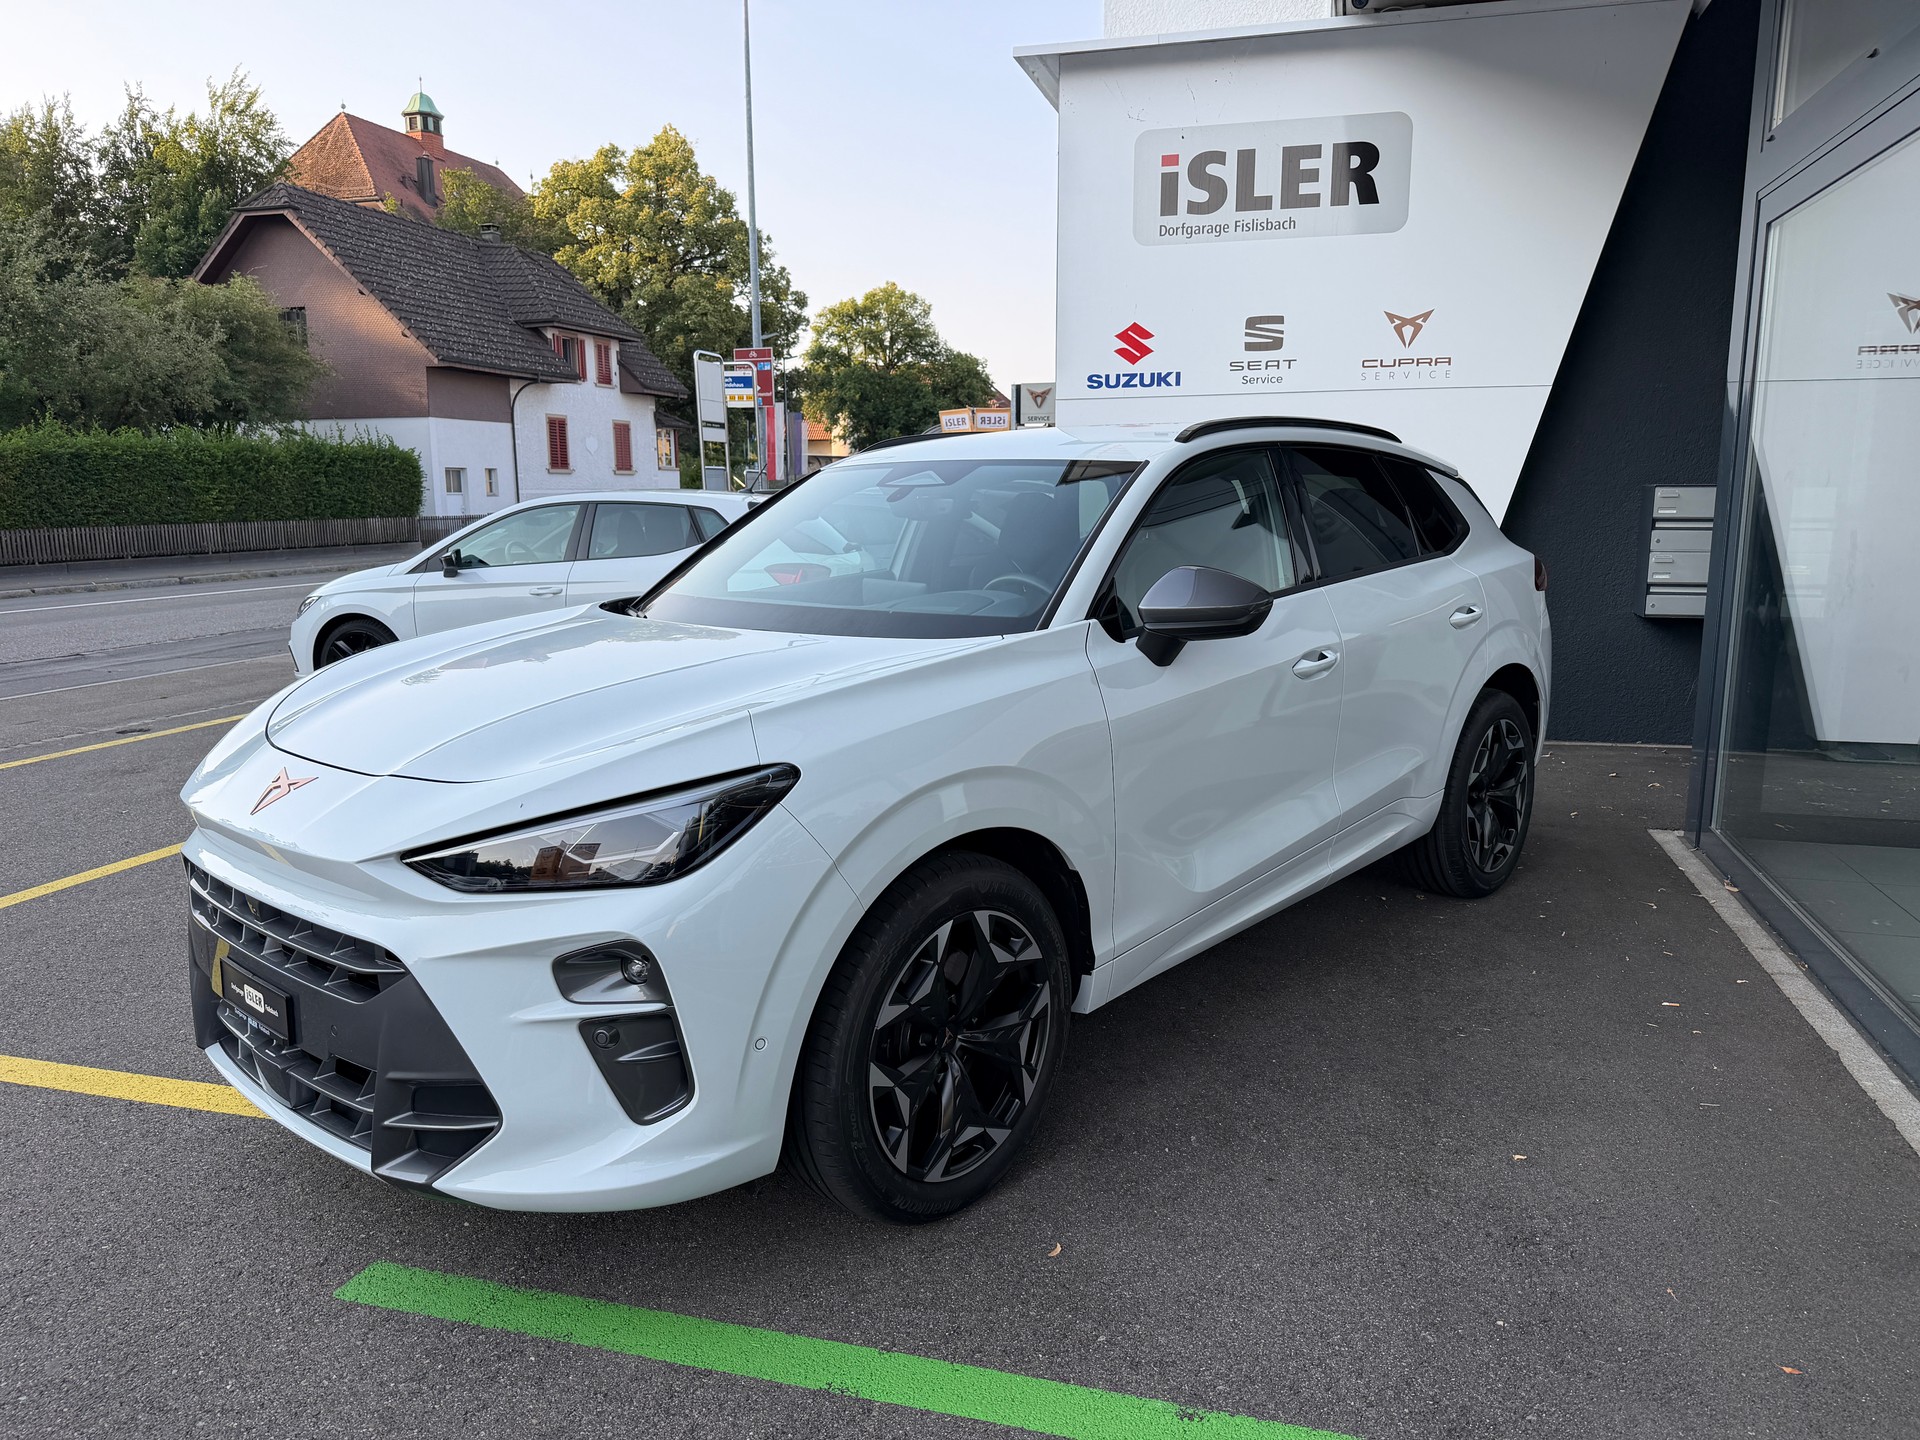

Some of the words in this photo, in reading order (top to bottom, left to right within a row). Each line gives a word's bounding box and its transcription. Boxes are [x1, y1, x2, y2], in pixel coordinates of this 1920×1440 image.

[1159, 222, 1230, 239] Dorfgarage
[1234, 216, 1297, 233] Fislisbach
[1229, 358, 1298, 372] SEAT
[1361, 356, 1452, 369] CUPRA
[1086, 371, 1182, 390] SUZUKI
[1241, 374, 1284, 385] Service
[1360, 369, 1452, 381] SERVICE
